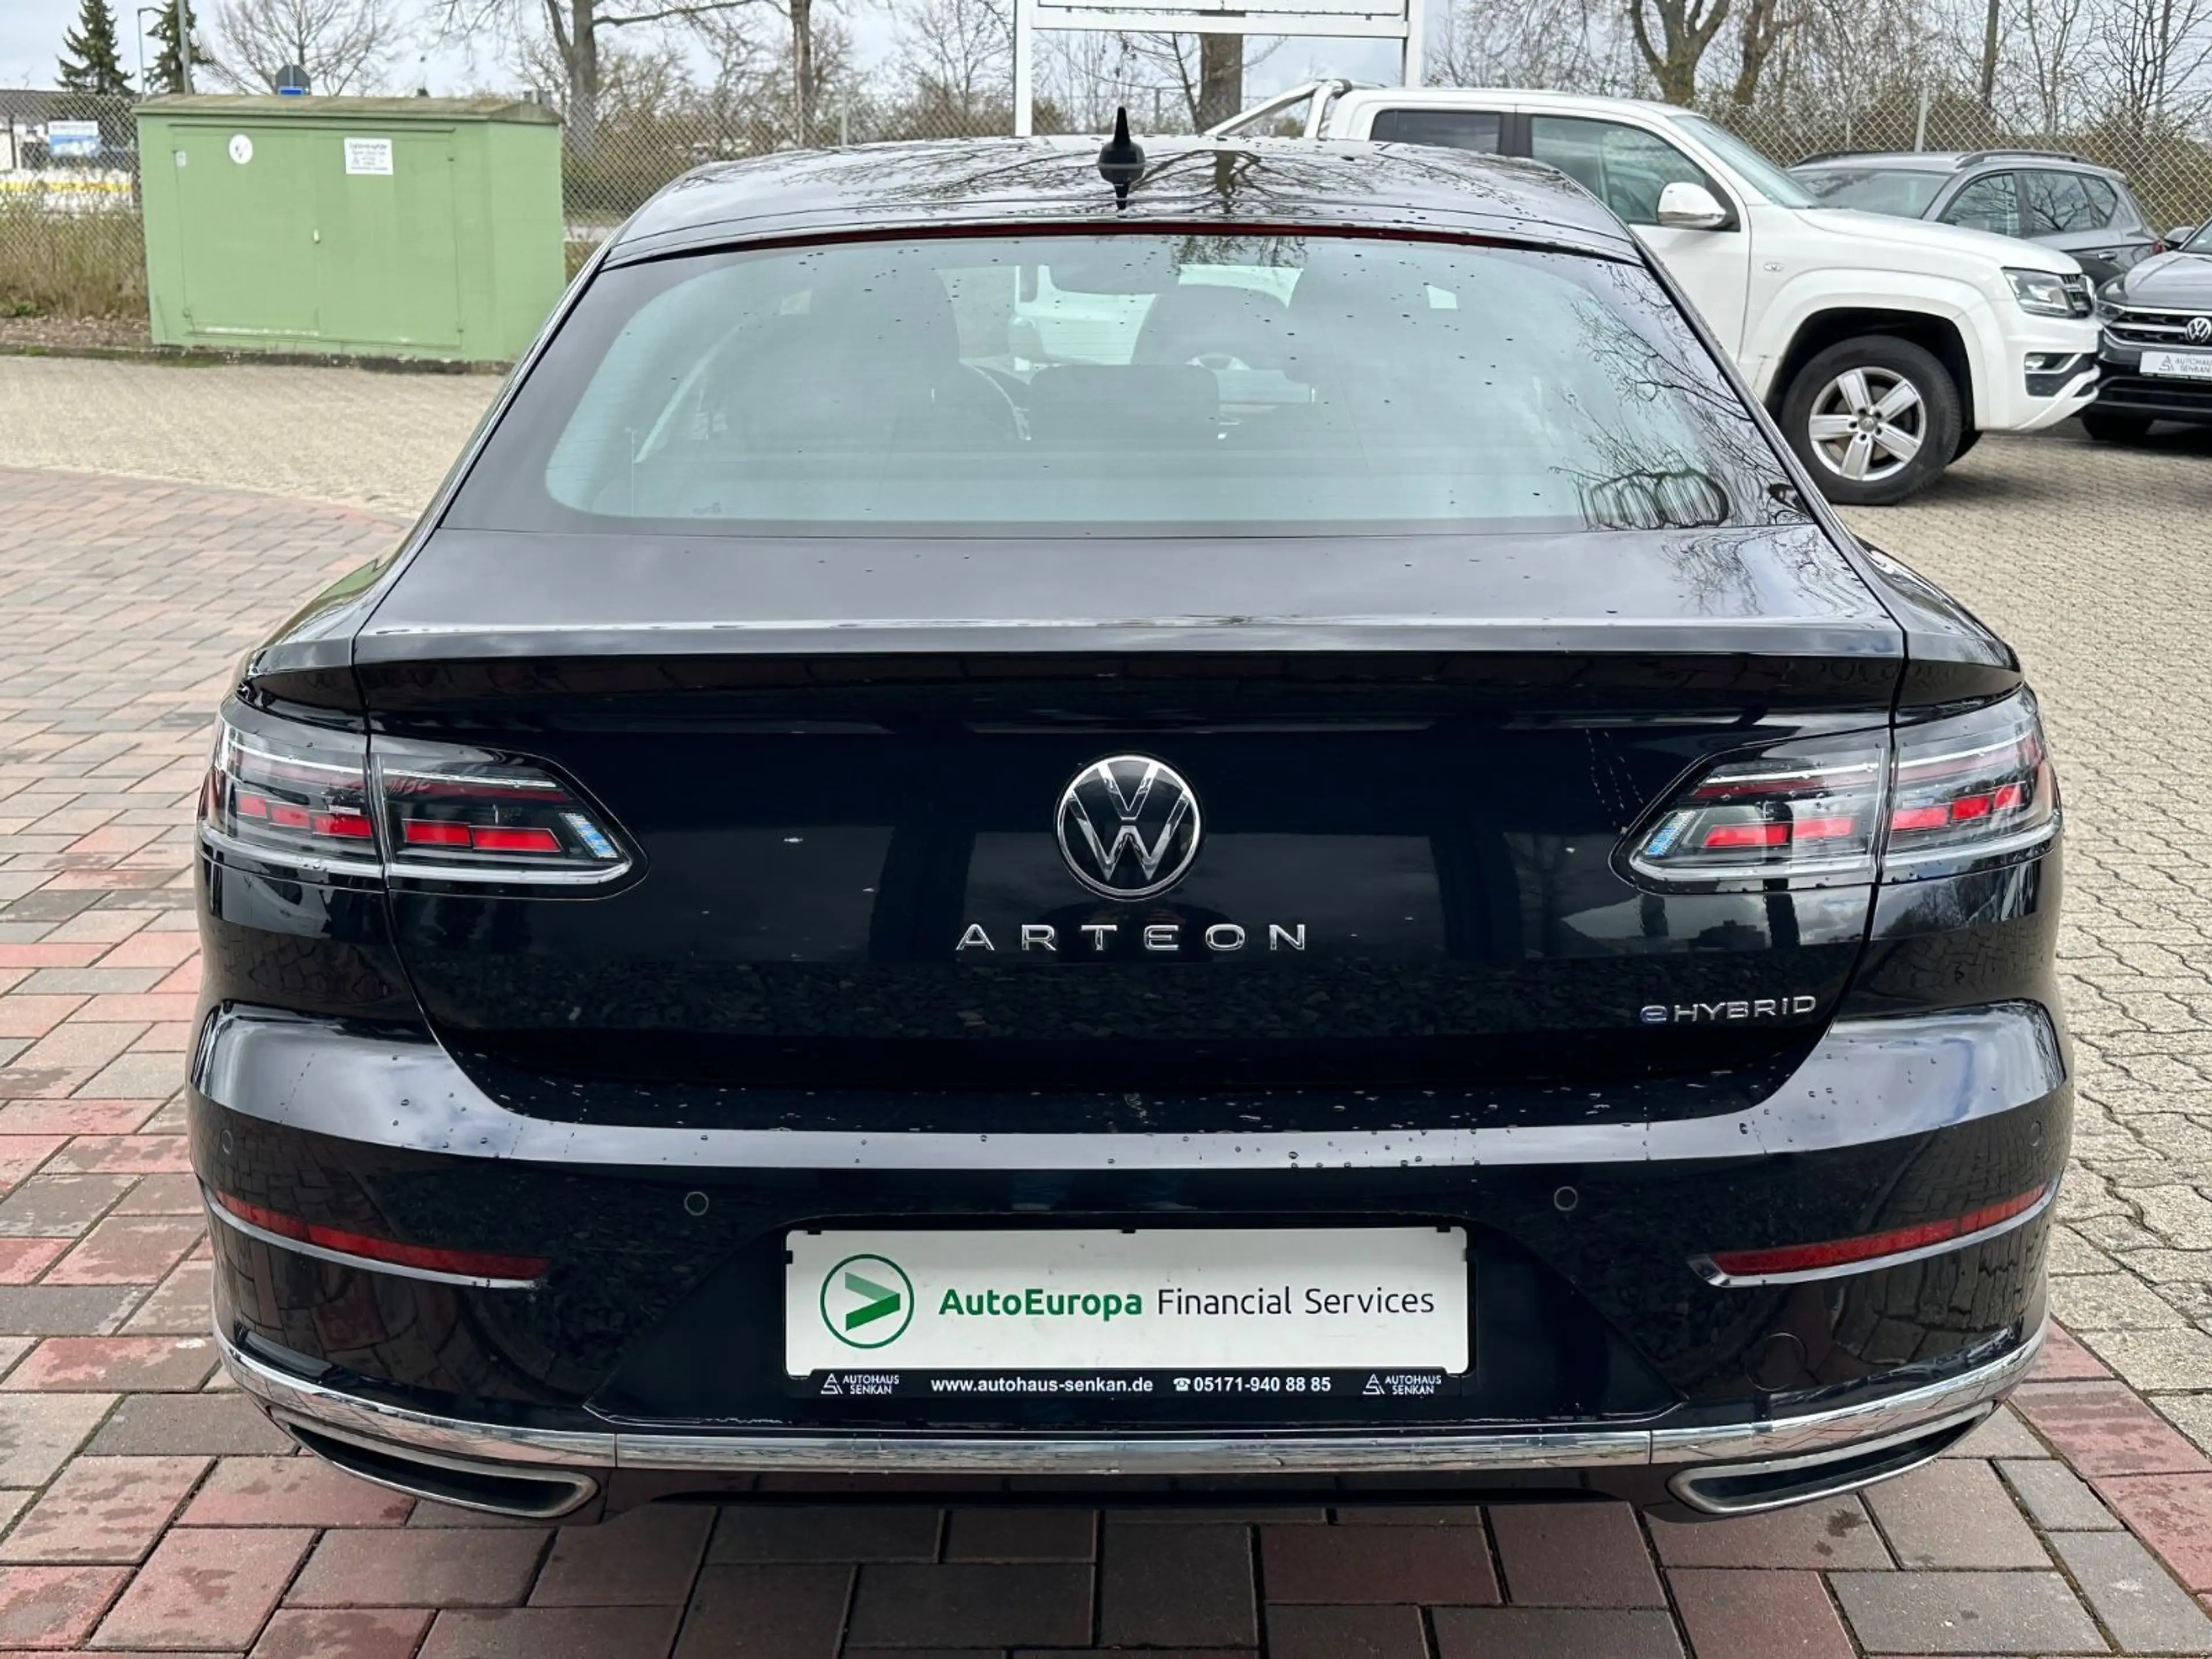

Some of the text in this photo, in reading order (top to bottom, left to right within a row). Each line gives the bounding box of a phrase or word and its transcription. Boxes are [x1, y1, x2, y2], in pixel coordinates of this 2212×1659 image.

[956, 923, 1306, 951] ARTEON
[938, 1286, 1434, 1321] AutoEuropa Financial Services
[843, 1374, 899, 1384] AUTOHAUS
[931, 1376, 1331, 1392] www.autohaus-senkan.de 05171-940 88 85
[1385, 1374, 1442, 1384] AUTOHAUS
[850, 1384, 892, 1395] SENKAN
[1392, 1384, 1434, 1395] SENKAN
